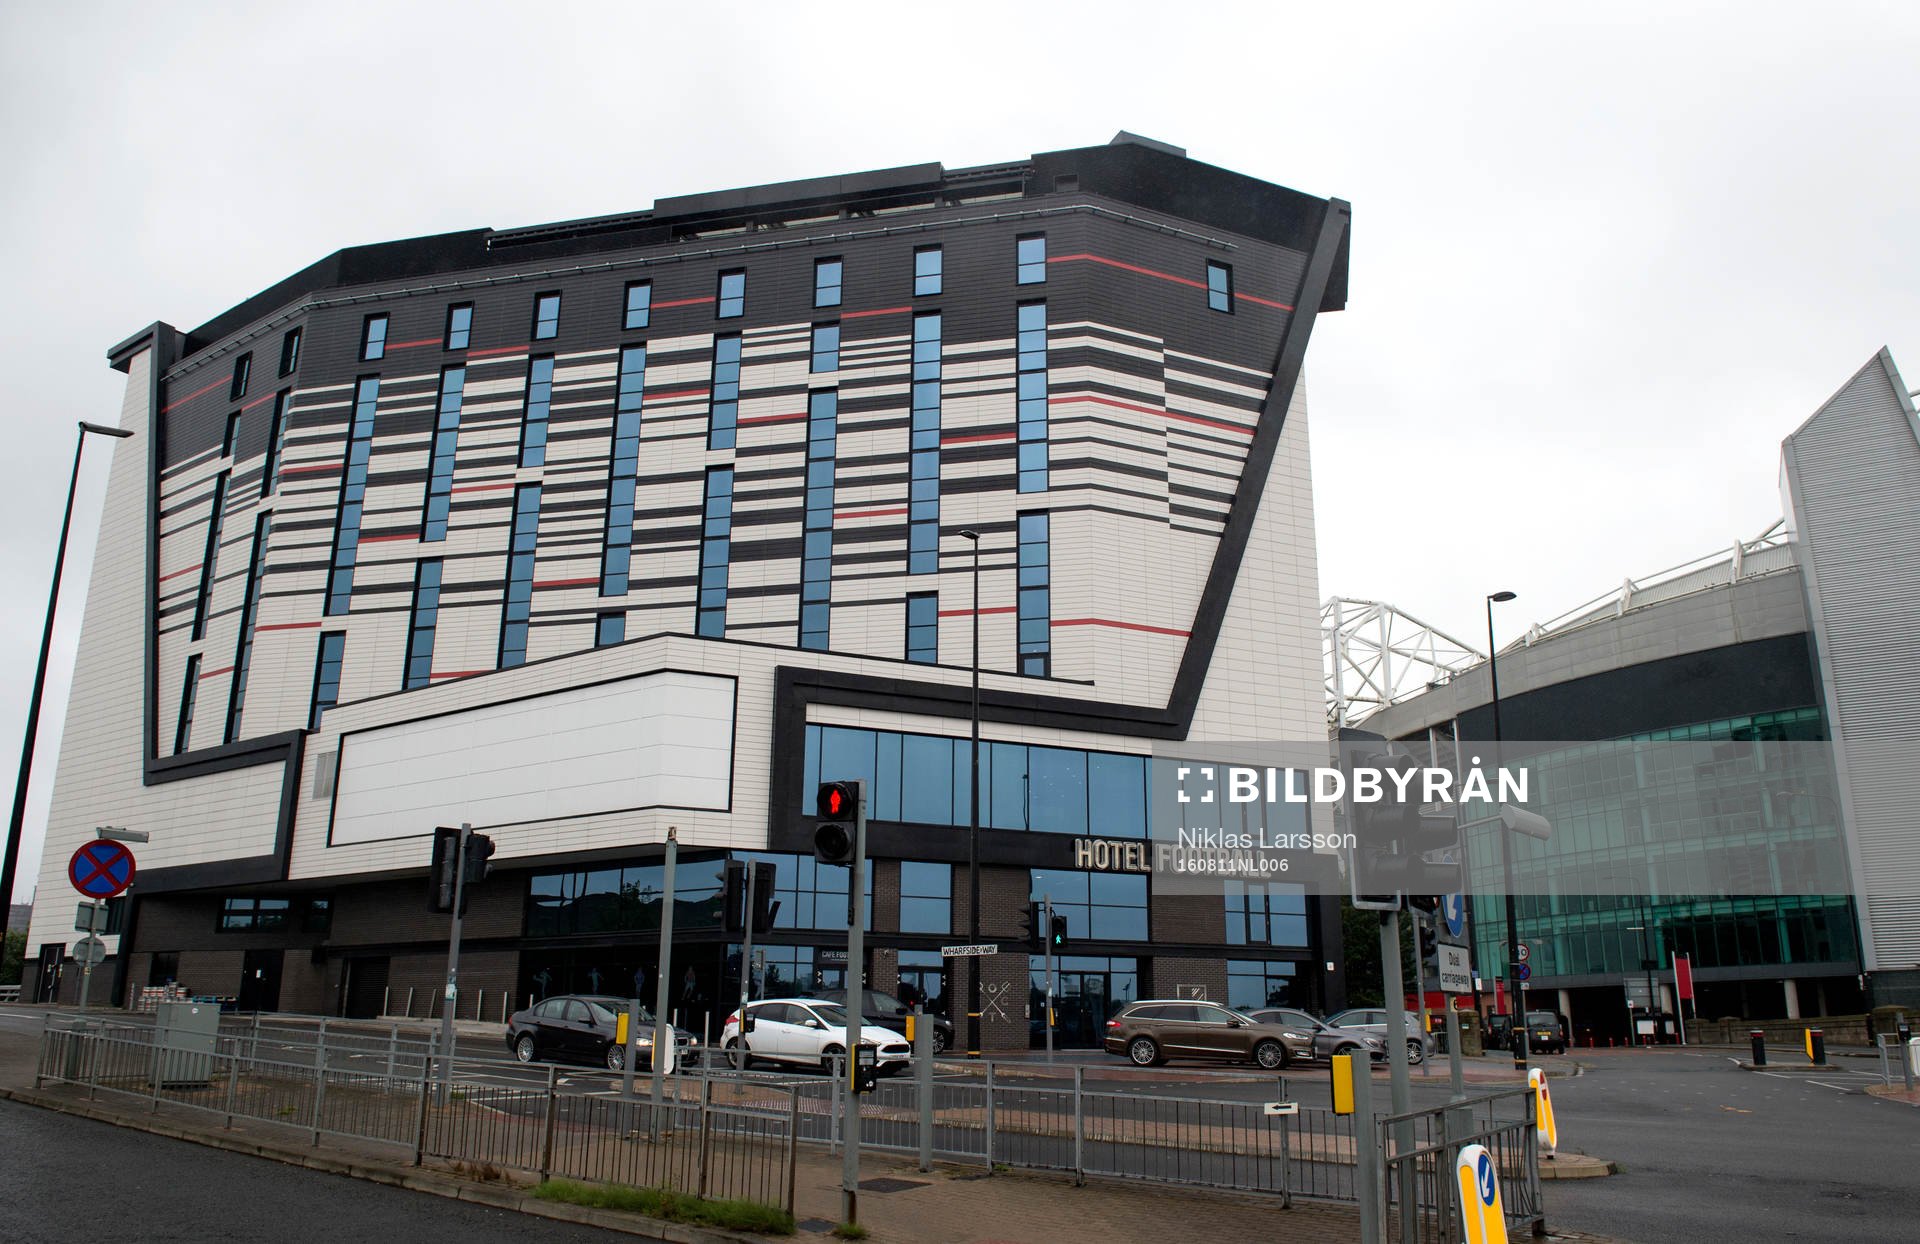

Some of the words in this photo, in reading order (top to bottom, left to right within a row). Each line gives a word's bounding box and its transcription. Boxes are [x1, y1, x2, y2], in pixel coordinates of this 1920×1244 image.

[1074, 838, 1151, 872] HOTEL
[1155, 843, 1272, 878] FOOTBALL
[943, 946, 980, 955] WHARFSIDE
[982, 945, 996, 954] WAY
